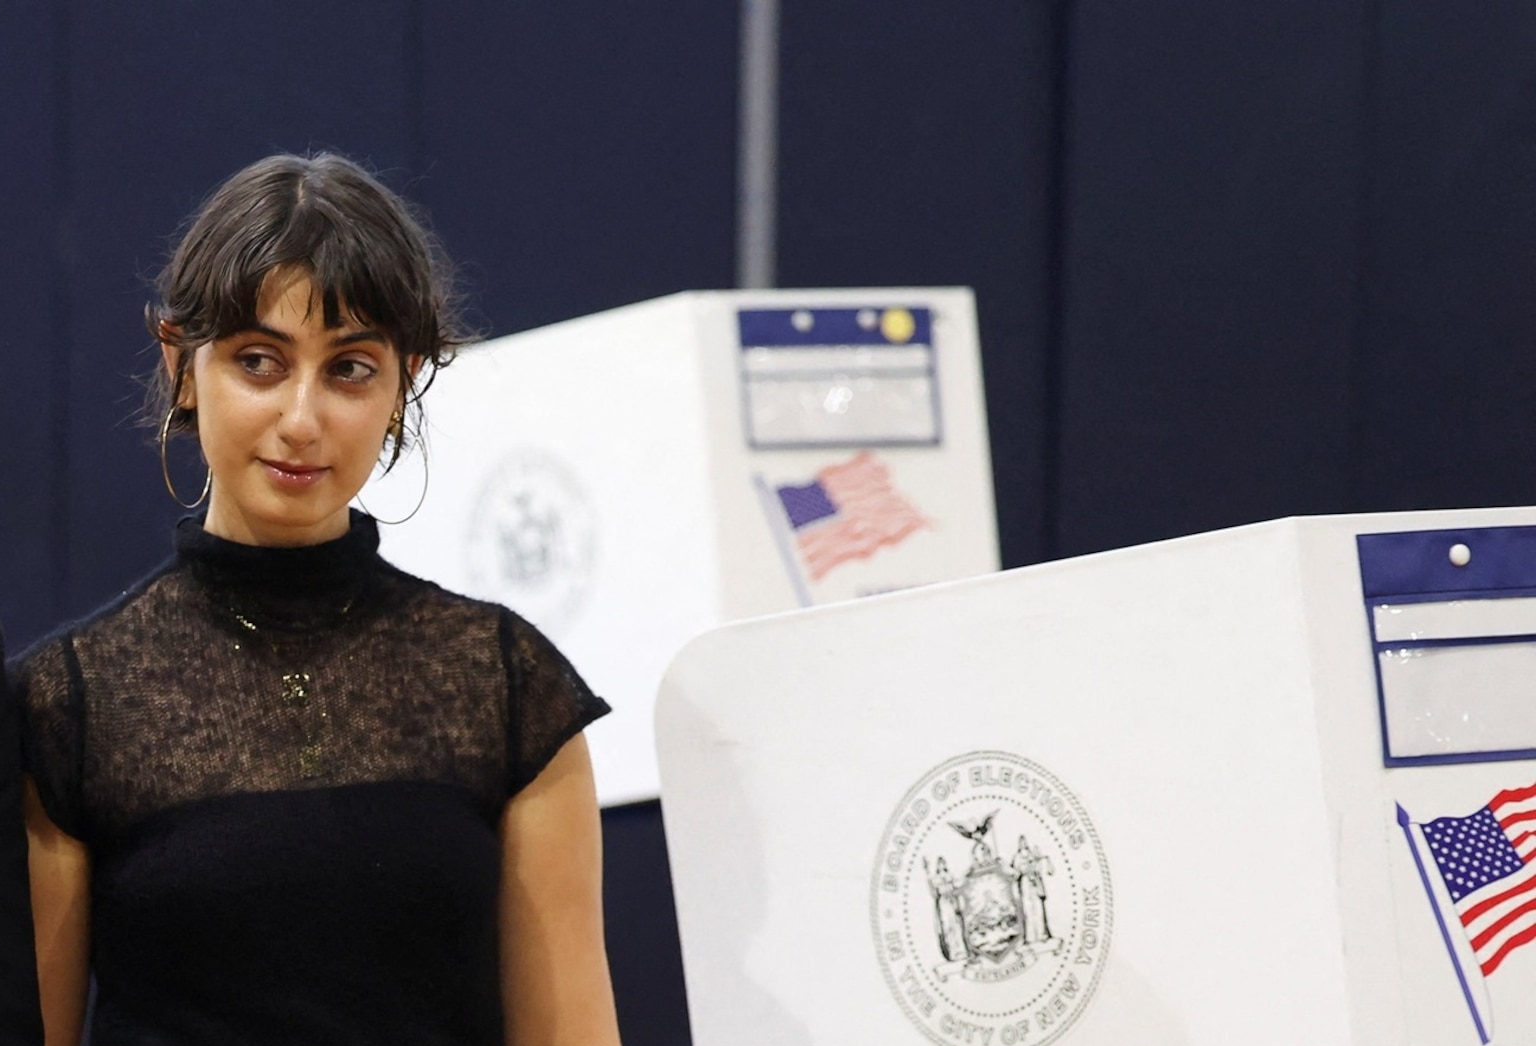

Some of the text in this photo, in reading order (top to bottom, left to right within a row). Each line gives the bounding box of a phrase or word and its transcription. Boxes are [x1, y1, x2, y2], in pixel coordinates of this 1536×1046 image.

[882, 766, 1086, 893] BOARD OF ELECTIONS
[883, 932, 905, 962] IN
[898, 966, 933, 1017] THE
[939, 1014, 995, 1046] CITY
[999, 1020, 1030, 1046] OF
[1037, 975, 1083, 1031] NEW
[1075, 885, 1100, 966] YORK
